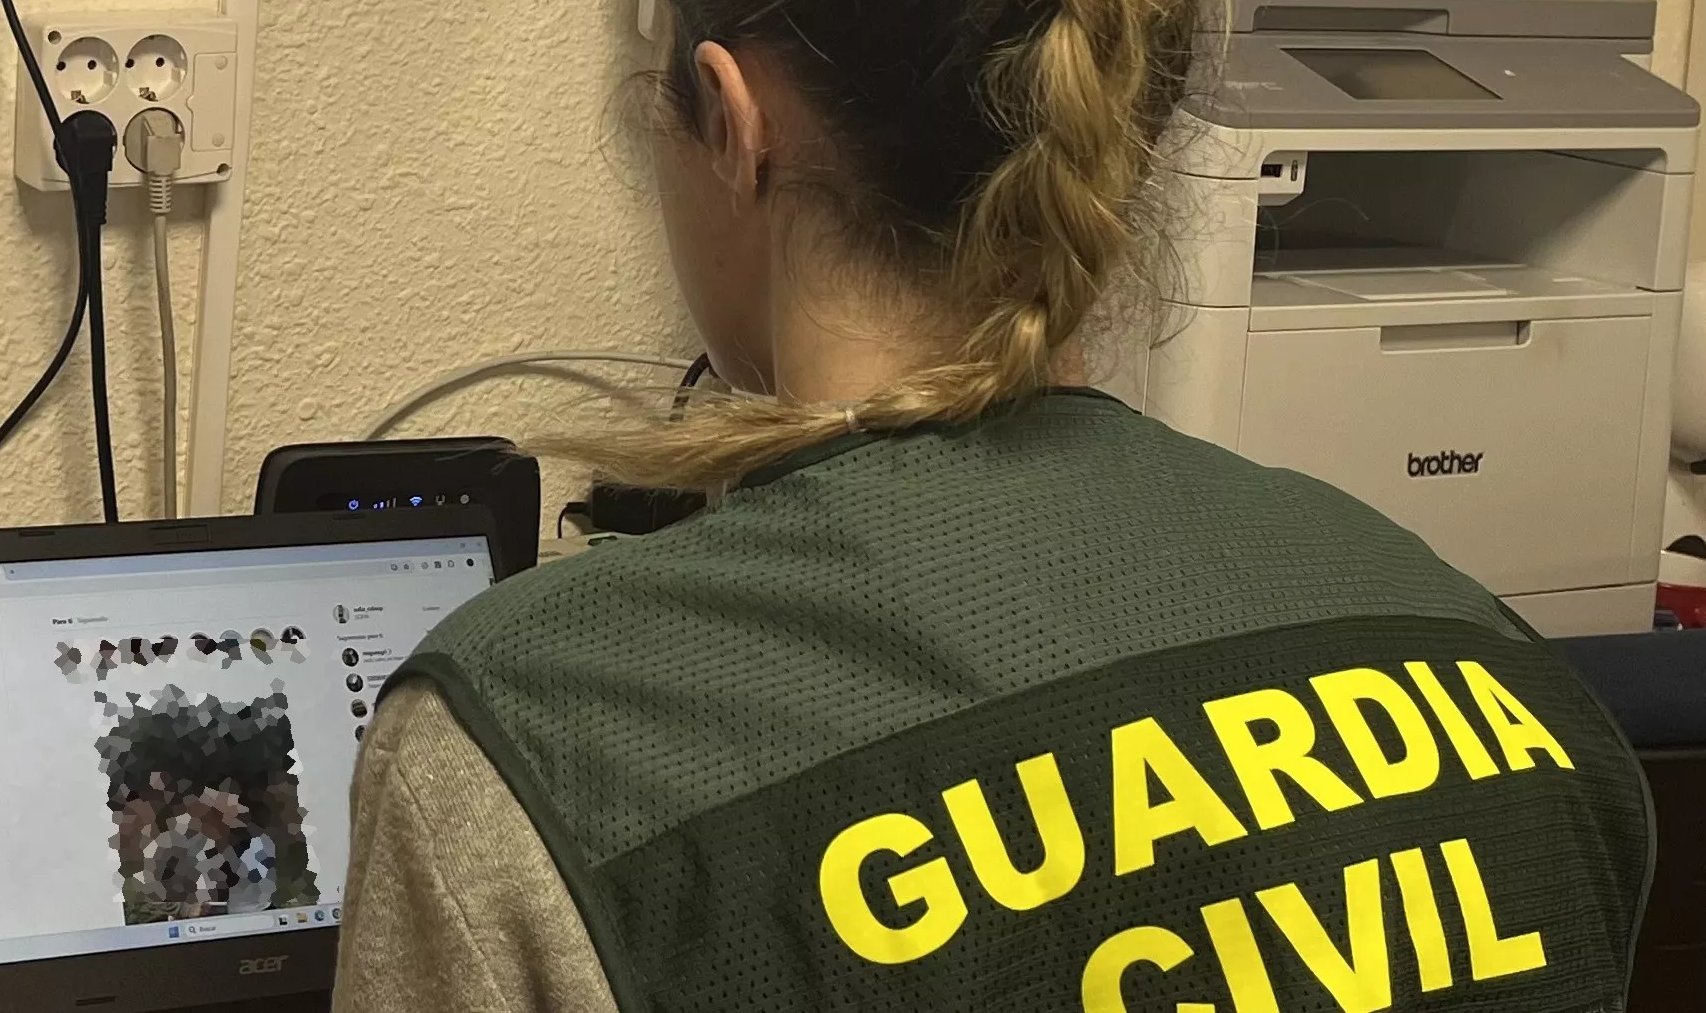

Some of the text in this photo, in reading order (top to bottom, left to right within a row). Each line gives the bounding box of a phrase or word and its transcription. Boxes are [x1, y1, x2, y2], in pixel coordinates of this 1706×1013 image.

[1407, 449, 1484, 478] brother
[818, 659, 1575, 965] GUARDIA
[238, 954, 290, 976] acer
[1080, 836, 1548, 1013] CIVIL
